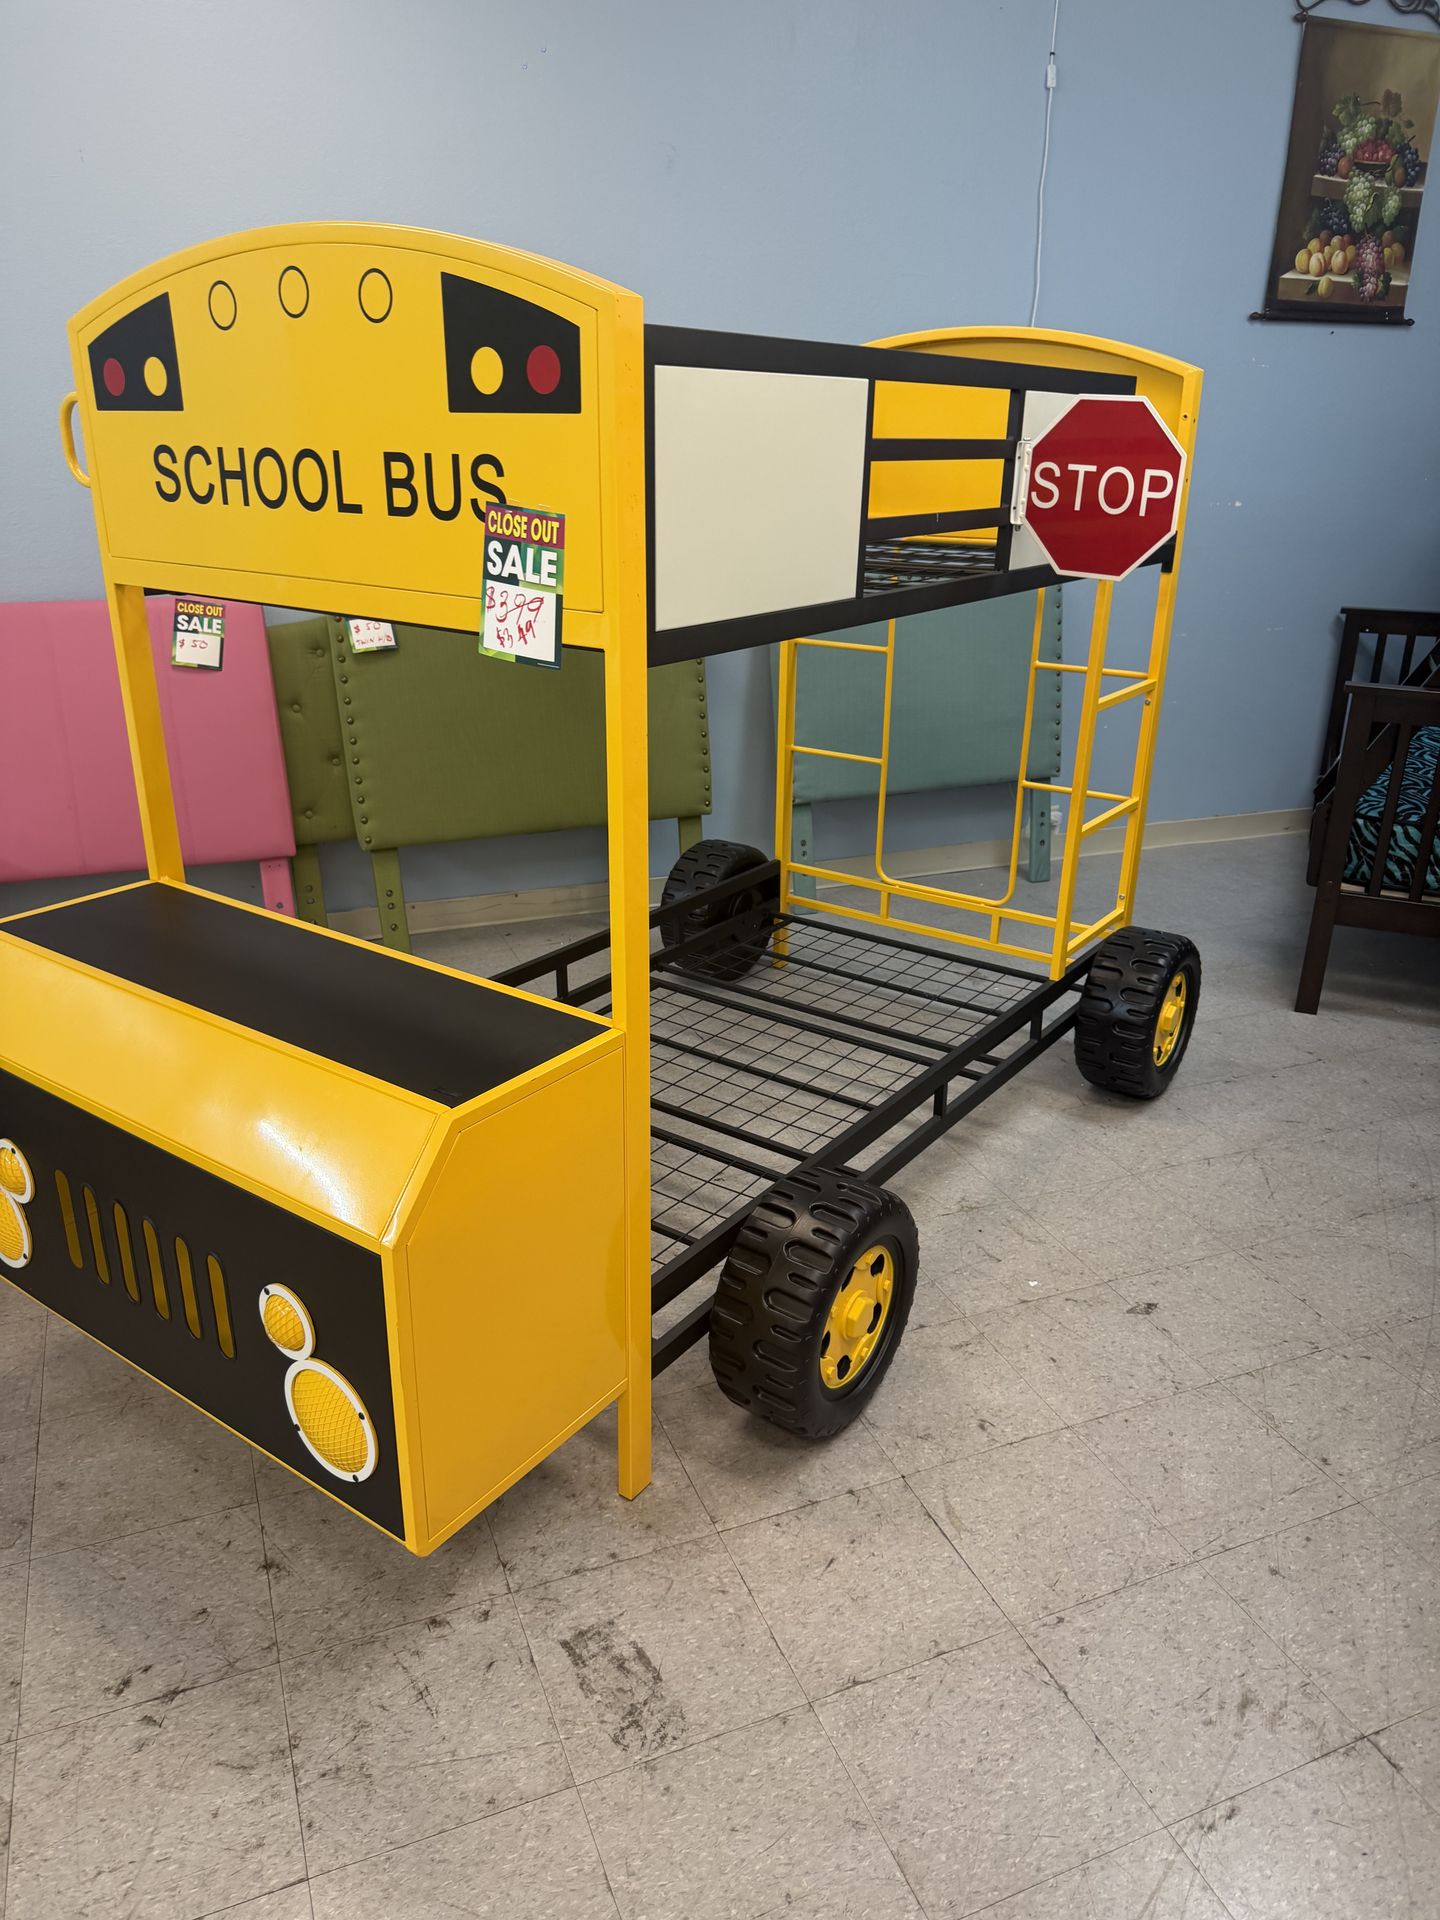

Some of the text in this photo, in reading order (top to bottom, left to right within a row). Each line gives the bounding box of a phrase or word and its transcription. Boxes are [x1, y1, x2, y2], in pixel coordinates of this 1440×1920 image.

[153, 444, 508, 523] SCHOOL BUS
[1031, 461, 1174, 517] STOP
[487, 510, 560, 544] CLOSE OUT
[486, 540, 558, 587] SALE
[176, 614, 222, 635] SALE
[177, 602, 224, 617] CLOSE OUT
